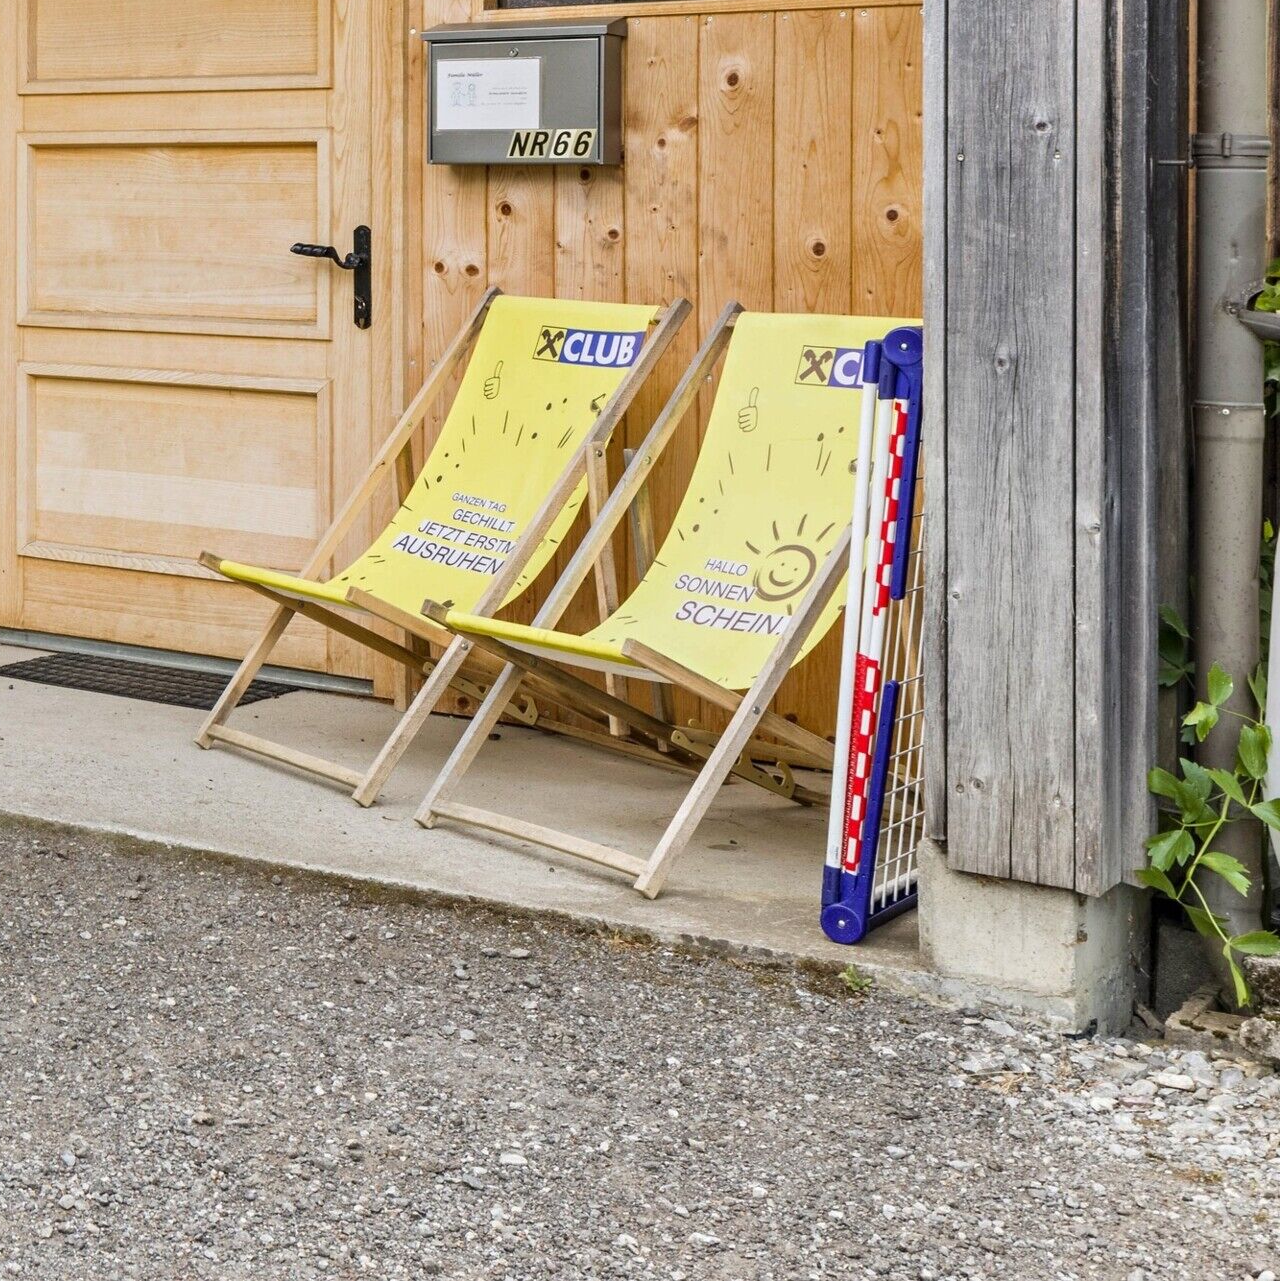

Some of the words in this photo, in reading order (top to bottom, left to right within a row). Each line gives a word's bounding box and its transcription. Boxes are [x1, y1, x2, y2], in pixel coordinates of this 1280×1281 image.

[563, 331, 636, 365] CLUB
[451, 492, 486, 508] GANZEN
[488, 500, 507, 513] TAG
[417, 521, 466, 542] JETZT
[393, 535, 505, 575] AUSRUHEN
[704, 558, 748, 577] HALLO
[674, 574, 756, 602] SONNEN
[675, 600, 784, 635] SCHEIN.
